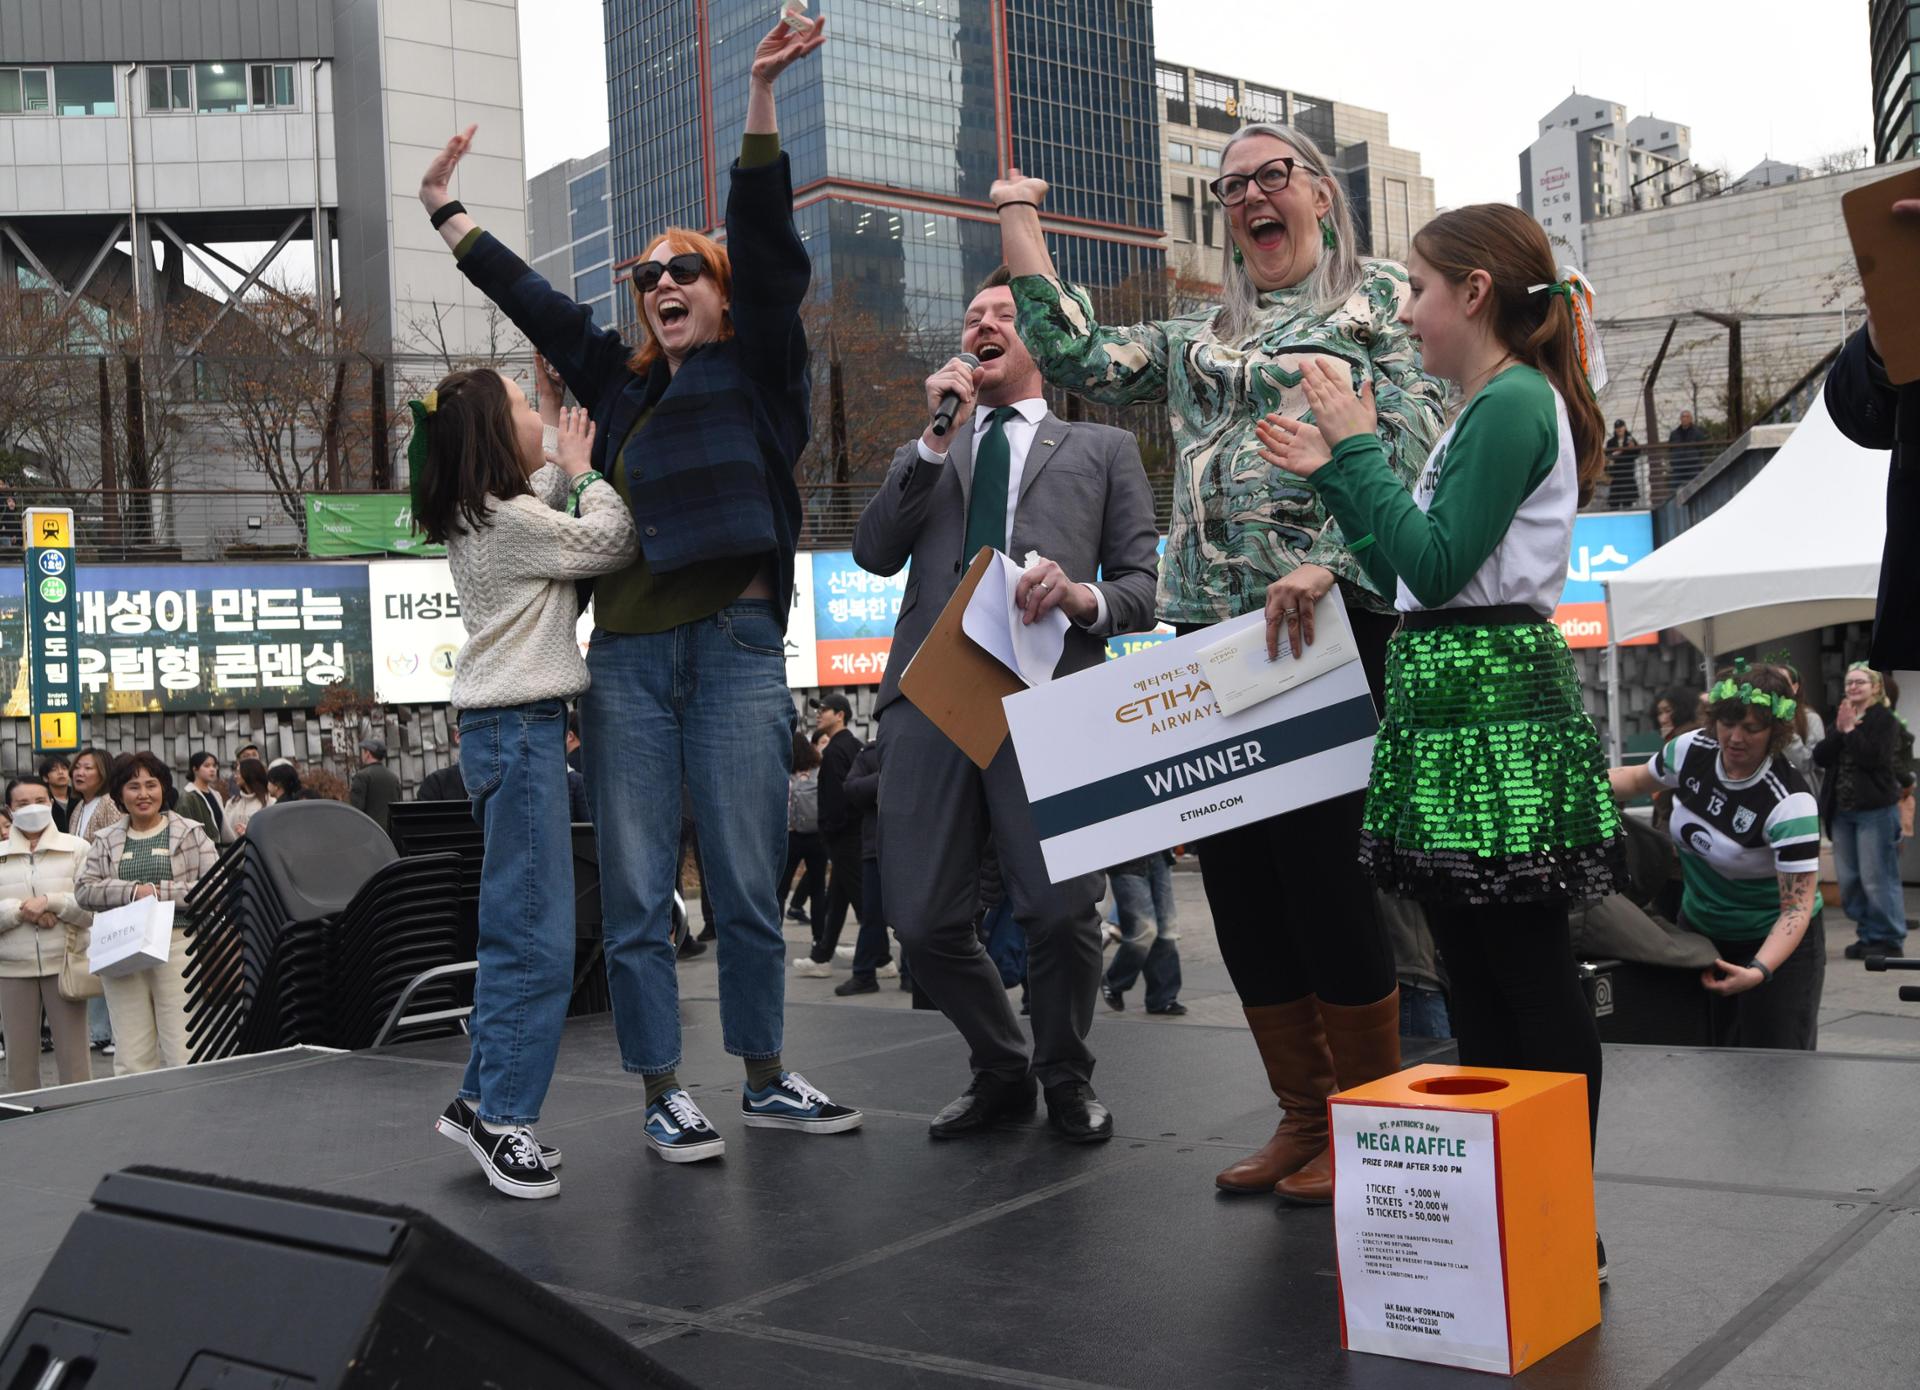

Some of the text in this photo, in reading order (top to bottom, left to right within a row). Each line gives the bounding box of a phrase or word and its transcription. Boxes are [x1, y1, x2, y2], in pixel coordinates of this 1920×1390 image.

[213, 588, 343, 632] 만드는
[828, 597, 887, 622] 행복한
[43, 611, 68, 683] 신도림
[215, 642, 344, 688] 콘덴싱
[1116, 680, 1212, 723] ETIHA
[54, 718, 61, 738] 1
[1151, 701, 1222, 735] AIRWAYS
[1144, 741, 1266, 796] WINNER
[1180, 795, 1243, 822] ETIHAD.COM
[1707, 795, 1724, 816] 13
[1379, 1120, 1440, 1133] ST. PATRICK'S DAY
[1356, 1131, 1466, 1157] MEGA RAFFLE
[1362, 1158, 1462, 1173] PRIZE DRAW AFTER 5:00 PM
[1371, 1184, 1396, 1194] TICKET
[1367, 1207, 1374, 1216] 15
[1376, 1208, 1407, 1219] TICKETS
[1372, 1196, 1403, 1207] TICKETS
[1396, 1304, 1412, 1313] BANK
[1414, 1307, 1455, 1320] INFORMATION
[1425, 1327, 1441, 1336] BANK
